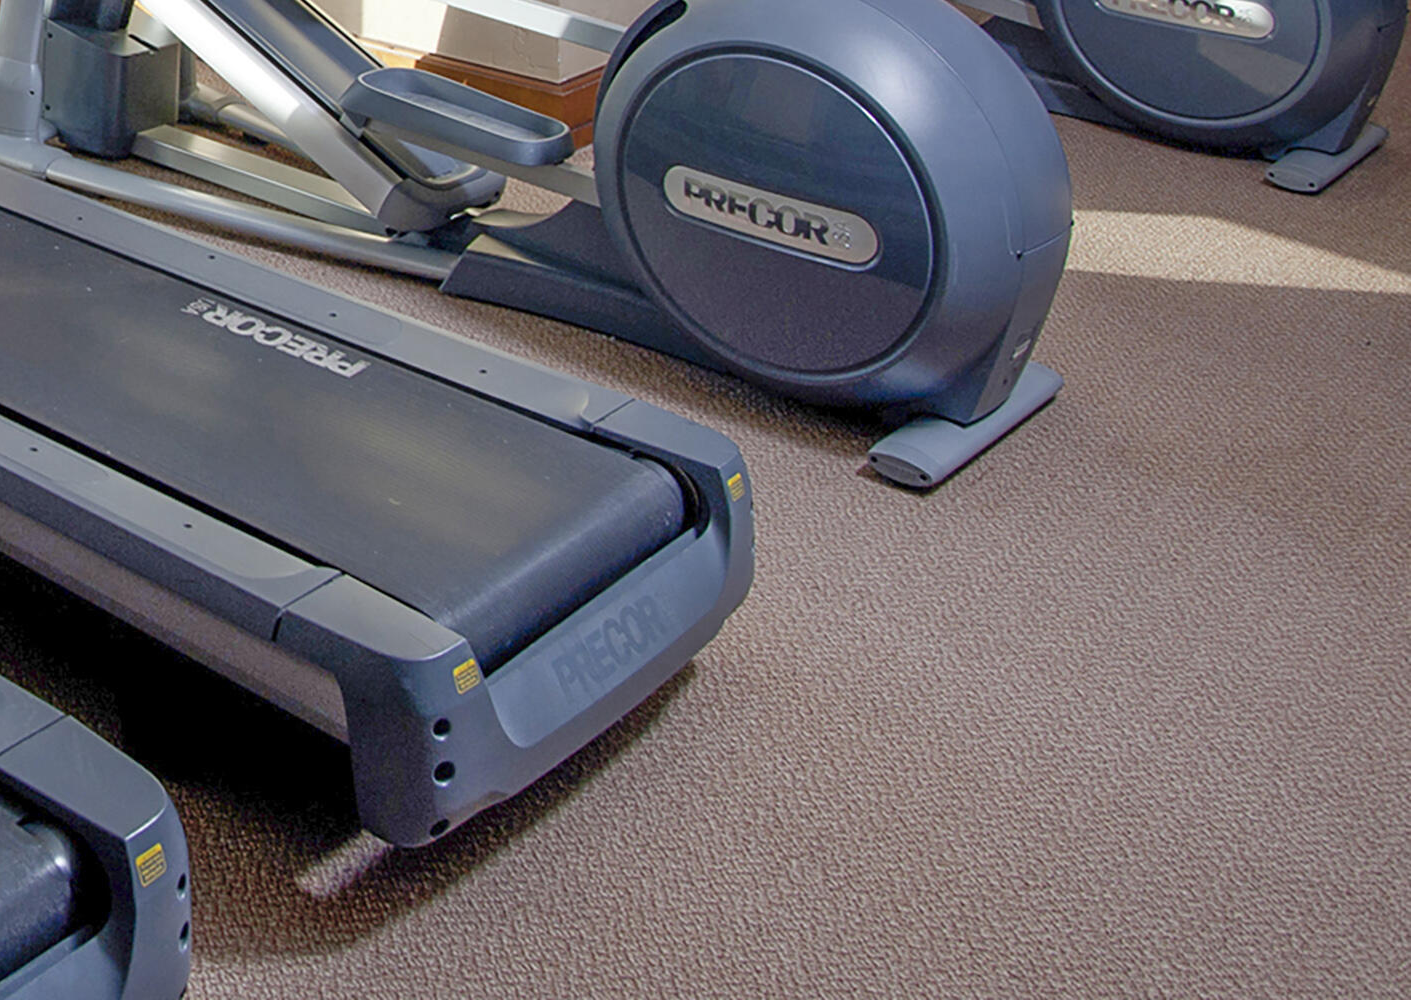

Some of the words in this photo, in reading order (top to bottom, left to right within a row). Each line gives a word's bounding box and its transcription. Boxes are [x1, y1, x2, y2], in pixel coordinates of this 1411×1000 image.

[684, 176, 829, 246] PRECOR
[202, 304, 371, 379] PRECOR
[551, 595, 668, 705] PRECOR
